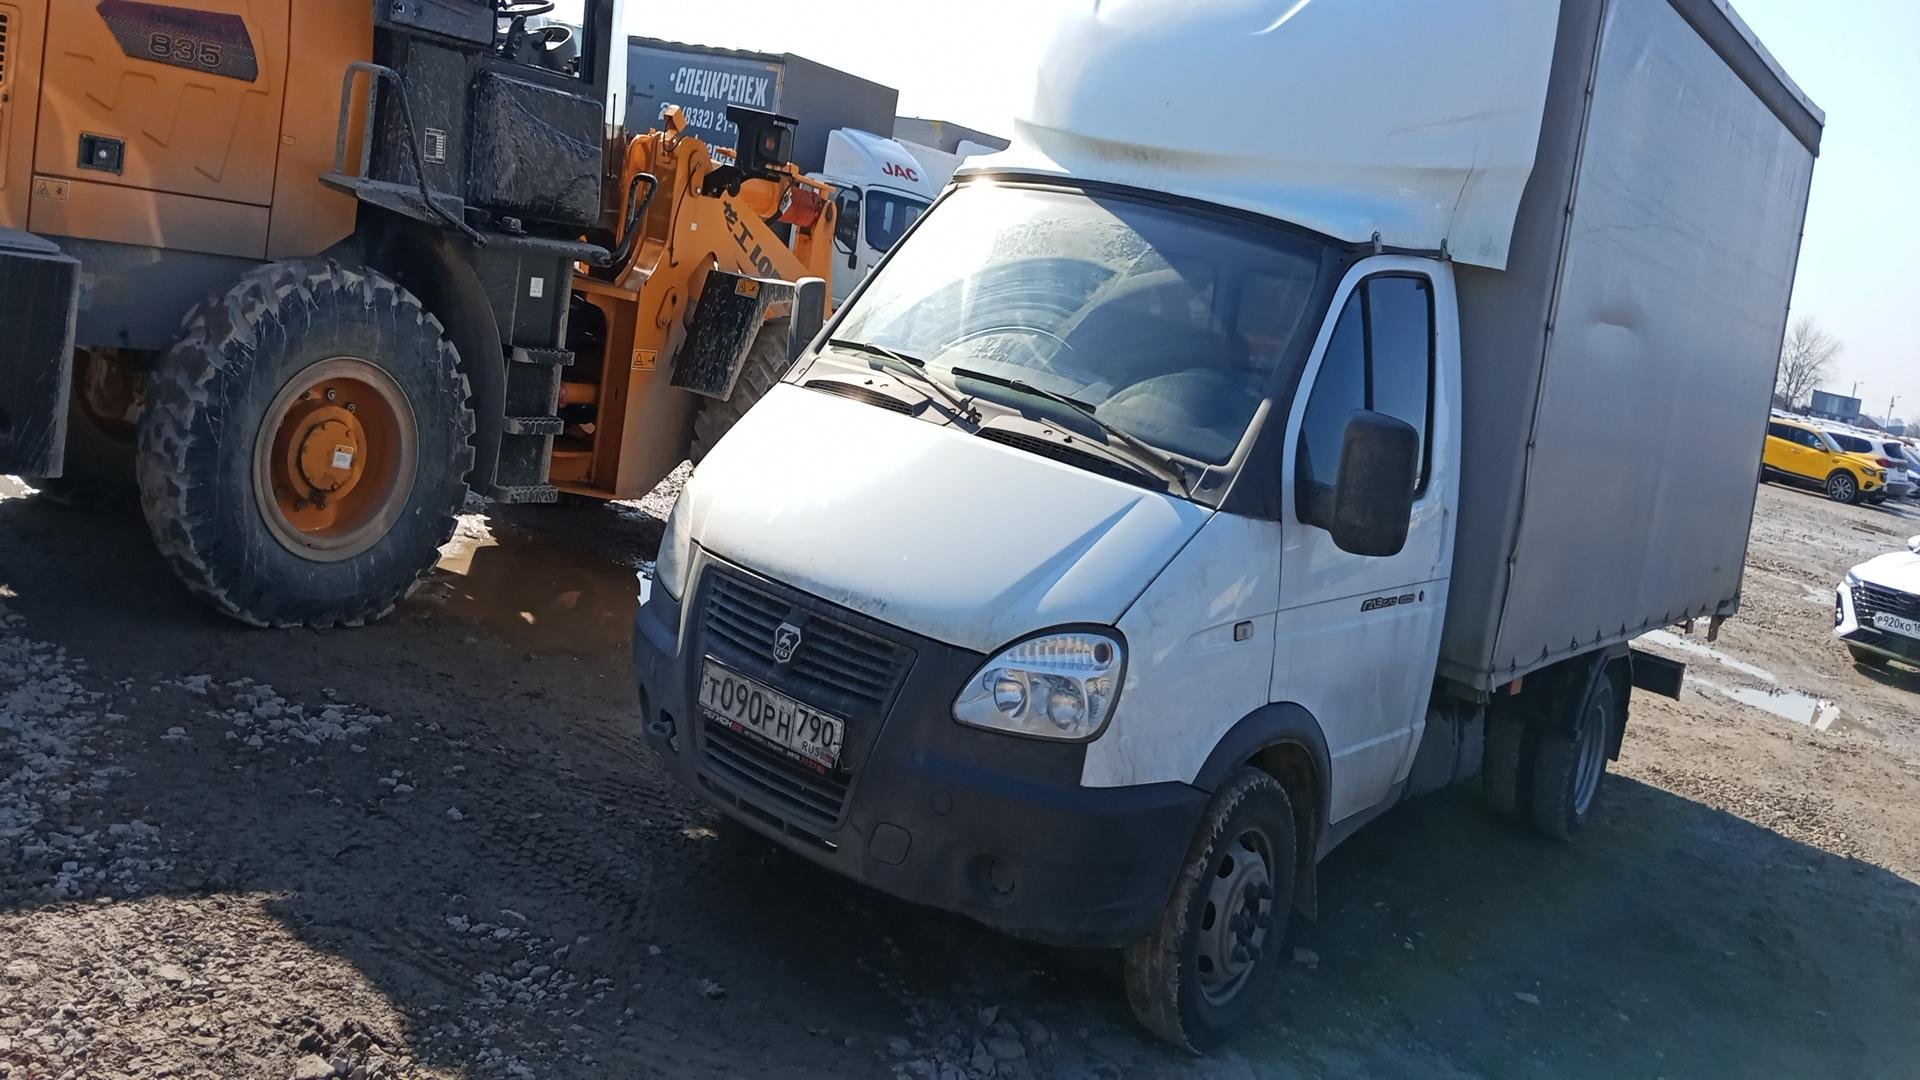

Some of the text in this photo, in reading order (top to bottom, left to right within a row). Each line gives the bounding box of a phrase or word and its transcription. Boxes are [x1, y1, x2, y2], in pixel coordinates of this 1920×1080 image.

[148, 31, 221, 68] 835
[674, 66, 769, 107] СПЕЦКРЕПЕЖ
[881, 161, 919, 183] JAC
[797, 707, 835, 748] 790
[801, 740, 820, 757] RUS
